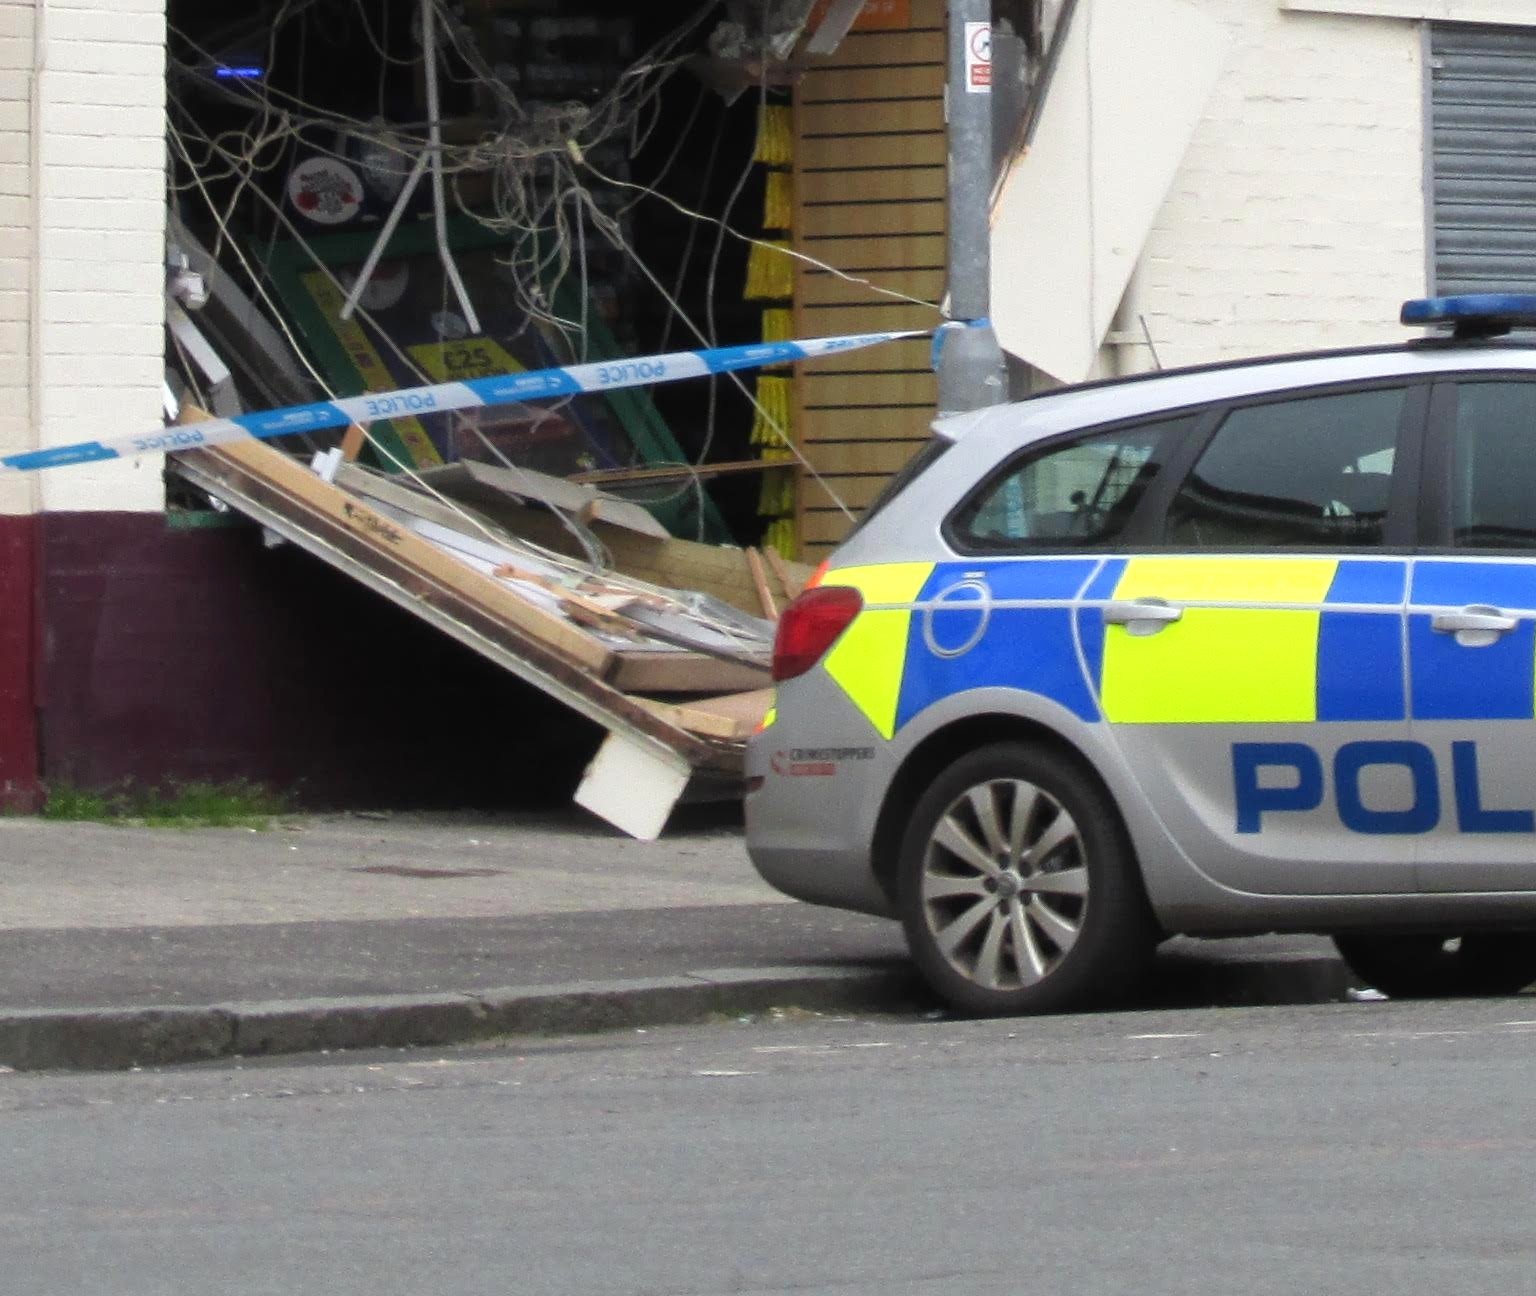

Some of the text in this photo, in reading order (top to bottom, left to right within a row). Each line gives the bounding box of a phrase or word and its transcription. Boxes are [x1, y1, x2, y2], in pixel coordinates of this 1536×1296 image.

[599, 360, 666, 384] POLICE
[368, 393, 436, 417] POLICE
[134, 430, 204, 451] POLICE
